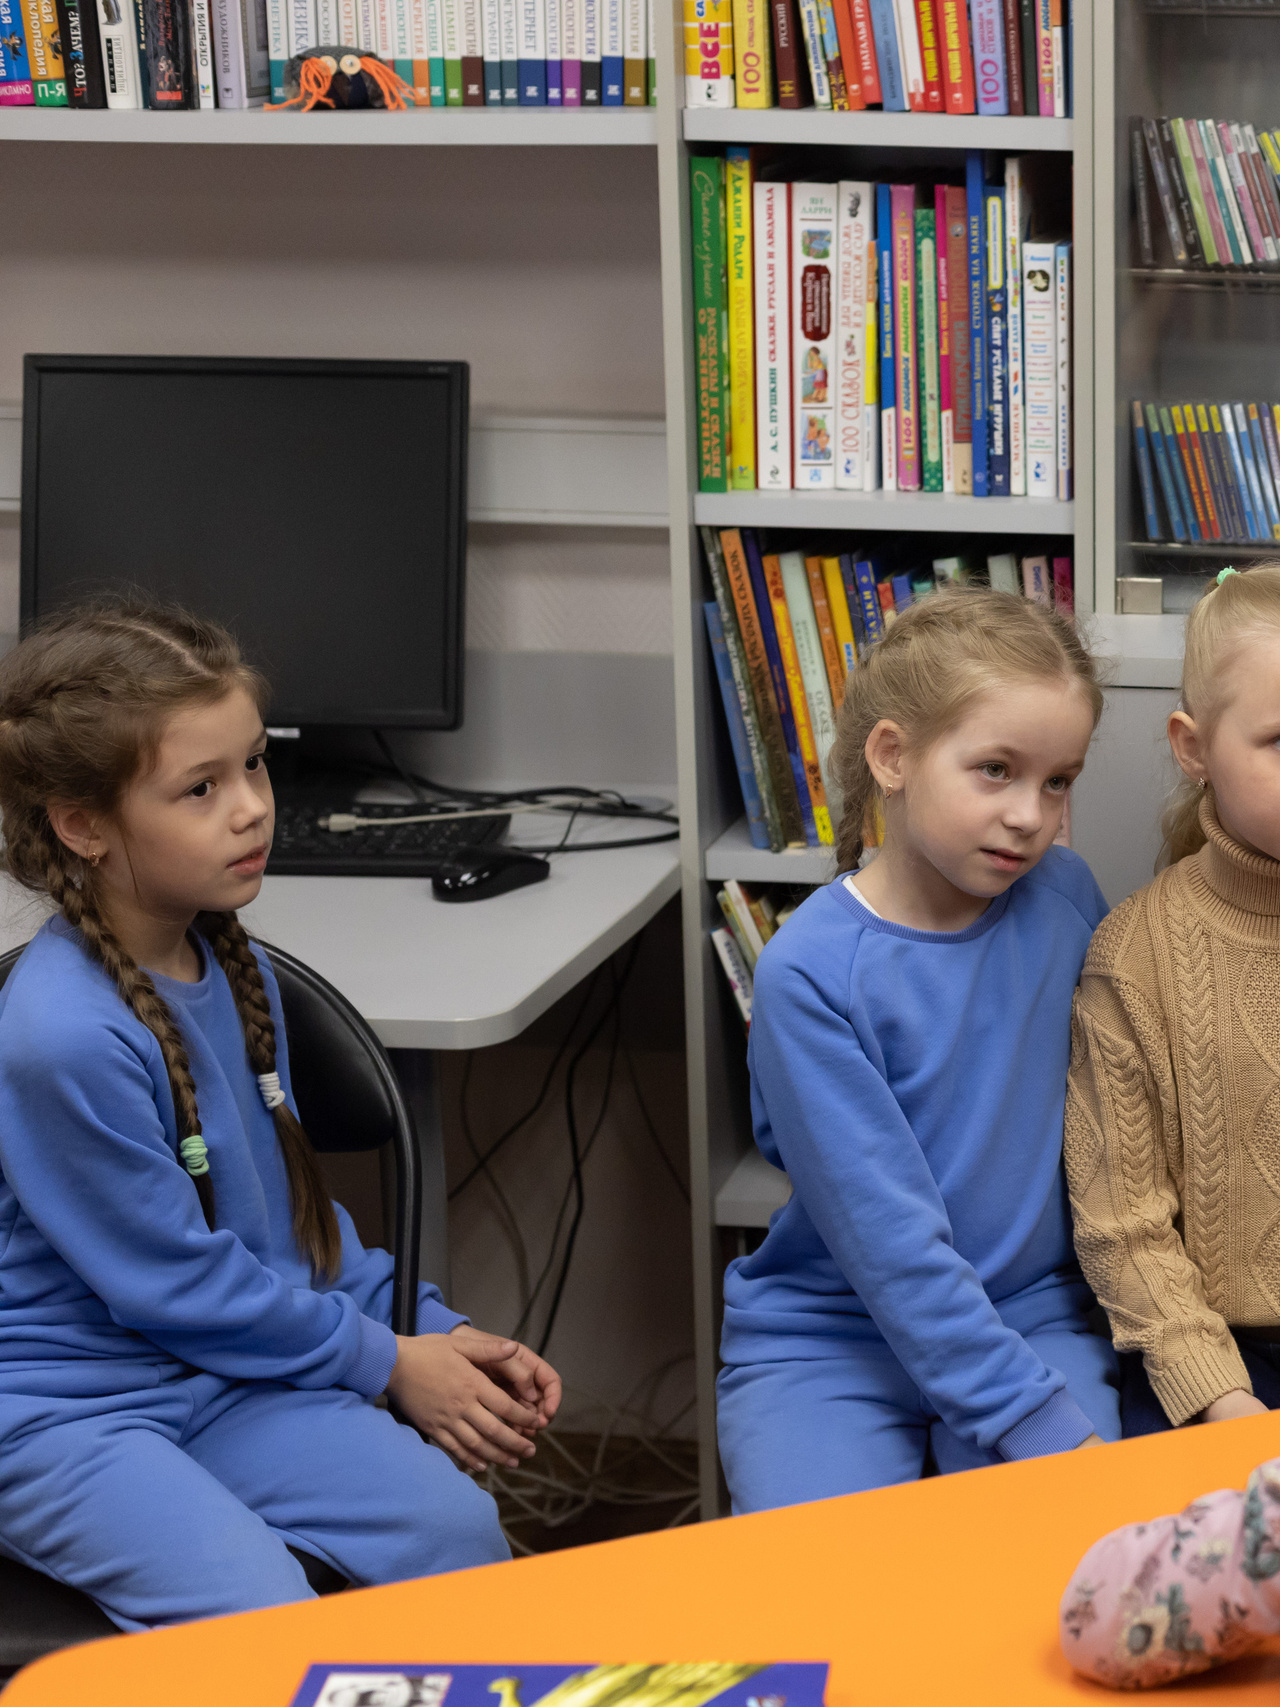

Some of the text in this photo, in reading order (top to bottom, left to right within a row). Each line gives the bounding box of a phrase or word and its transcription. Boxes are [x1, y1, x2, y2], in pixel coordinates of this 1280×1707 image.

[28, 0, 47, 76] клопедия
[68, 11, 84, 60] ЗАЧЕМ?
[198, 13, 208, 66] ОТКРЫТИЯ
[320, 0, 331, 47] ОСОФИ
[775, 3, 789, 47] РУССКИЙ
[856, 21, 872, 71] НАТАЛЬЯ
[699, 22, 720, 80] ВСЕ
[742, 52, 761, 94] 100
[37, 82, 66, 98] П-Я
[73, 63, 87, 97] ЧТО?
[980, 59, 1000, 104] 100
[766, 187, 776, 249] ЛЮДМИЛА
[970, 214, 980, 254] МАЯКЕ
[767, 263, 777, 309] РУСЛАН
[971, 259, 980, 276] НА
[972, 279, 982, 329] СТОРОЖ
[699, 308, 711, 479] О ЖИВОТНЫХ
[707, 307, 721, 479] РАССКАЗЫ И СКАЗКИ
[768, 367, 778, 423] ПУШКИН
[842, 358, 861, 454] 100 СКАЗОК
[770, 426, 778, 437] С.
[771, 441, 779, 453] А.
[903, 416, 913, 444] 100
[729, 549, 748, 602] СКАЗОК
